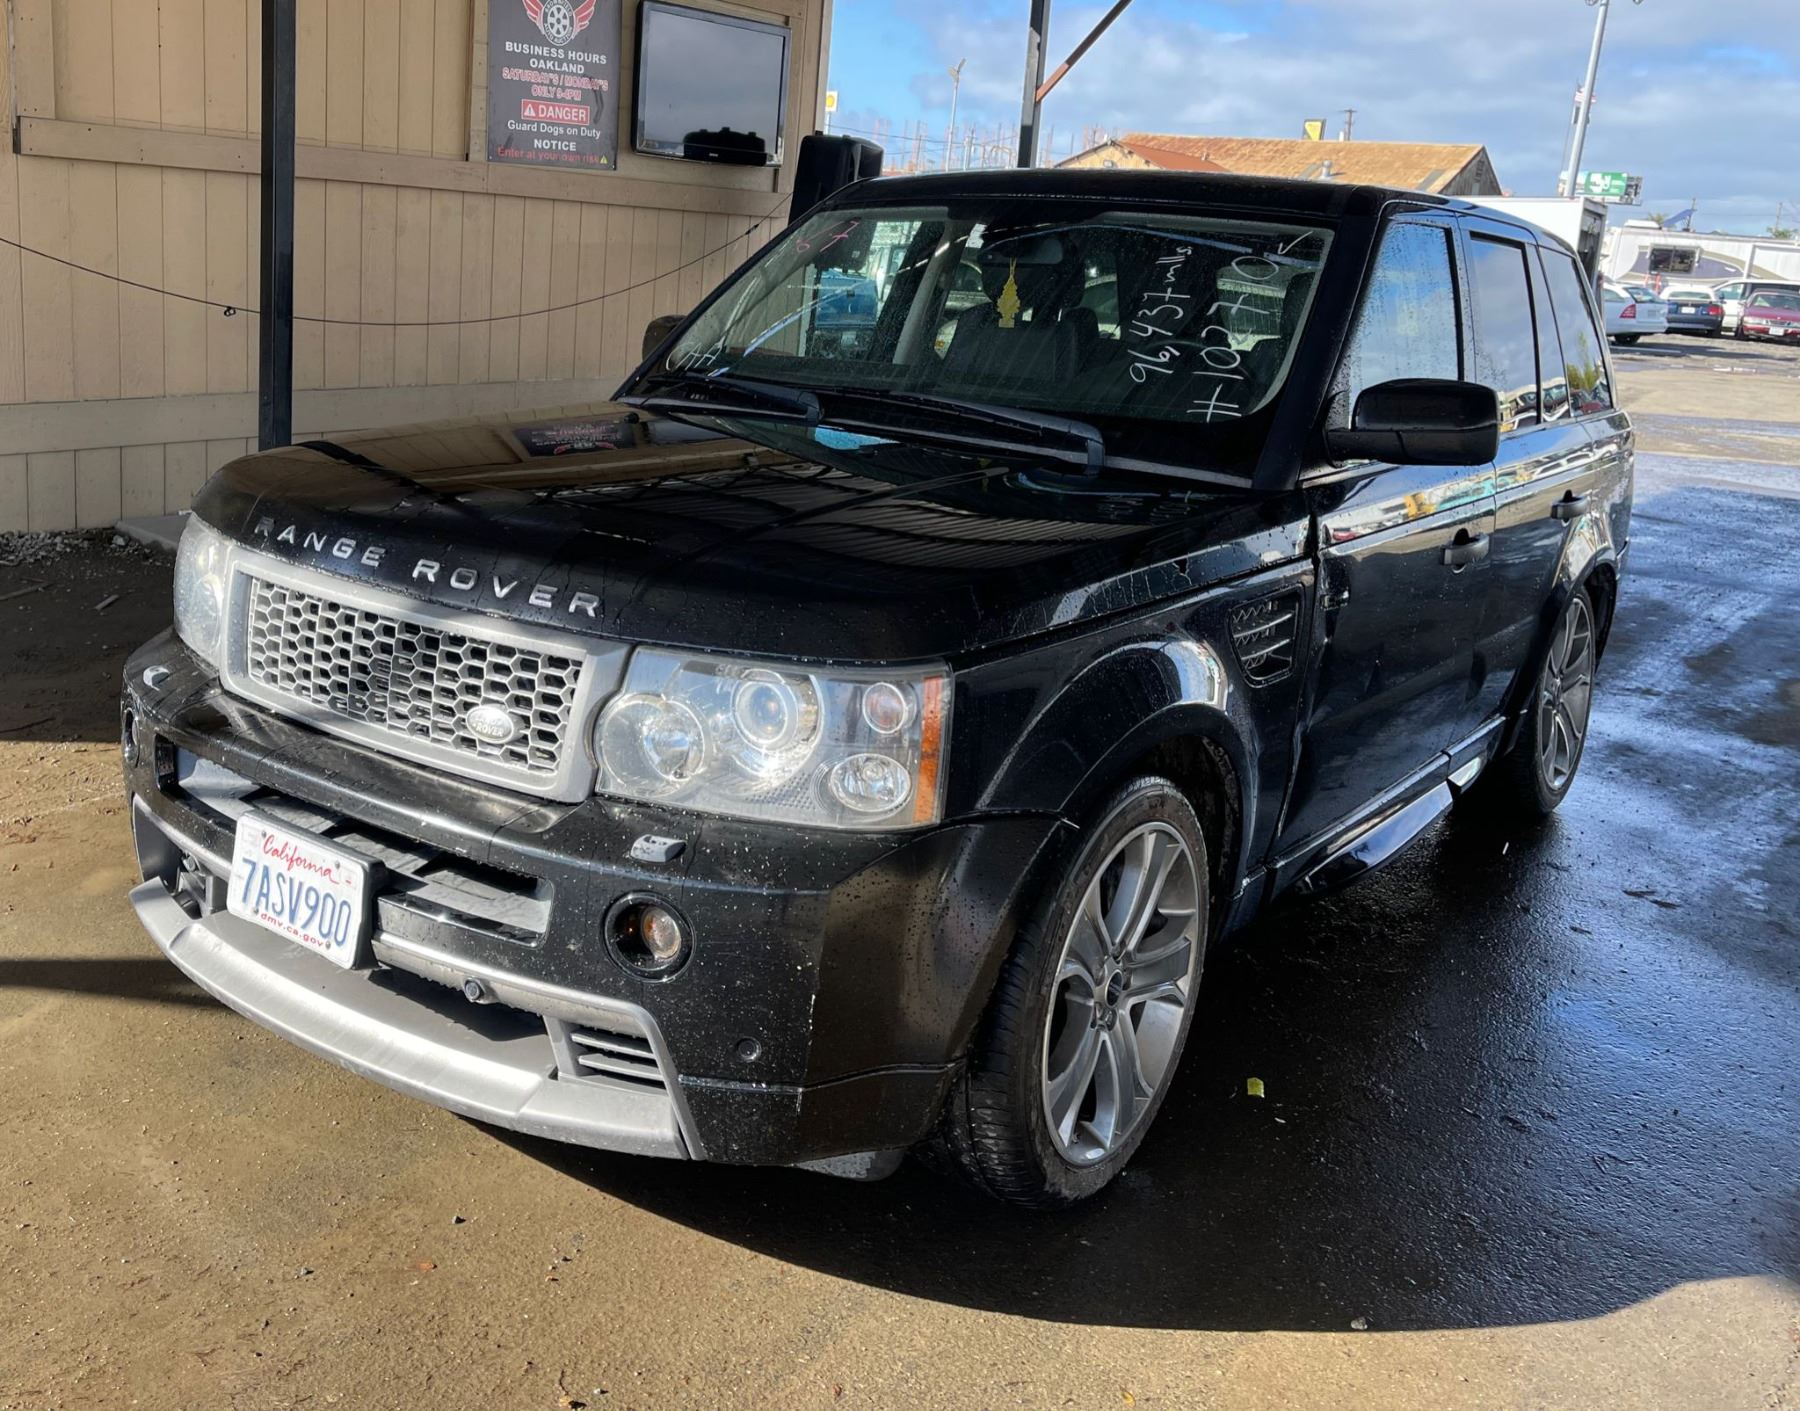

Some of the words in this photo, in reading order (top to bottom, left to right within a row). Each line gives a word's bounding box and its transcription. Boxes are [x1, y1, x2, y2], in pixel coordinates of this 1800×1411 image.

[505, 41, 565, 59] BUSINESS
[568, 51, 607, 65] HOURS
[530, 58, 585, 74] OAKLAND
[531, 84, 556, 98] ONLY
[538, 105, 586, 121] DANGER
[507, 119, 537, 132] Guard
[540, 123, 564, 136] Dogs
[566, 127, 578, 135] on
[580, 127, 601, 140] Duty
[498, 146, 523, 158] Enter
[538, 151, 560, 162] your
[534, 138, 577, 151] NOTICE
[254, 517, 386, 568] RANGE
[412, 558, 601, 617] ROVER
[262, 834, 339, 885] California
[242, 857, 352, 947] 7ASV900
[260, 911, 325, 948] dmv.ca.gov
